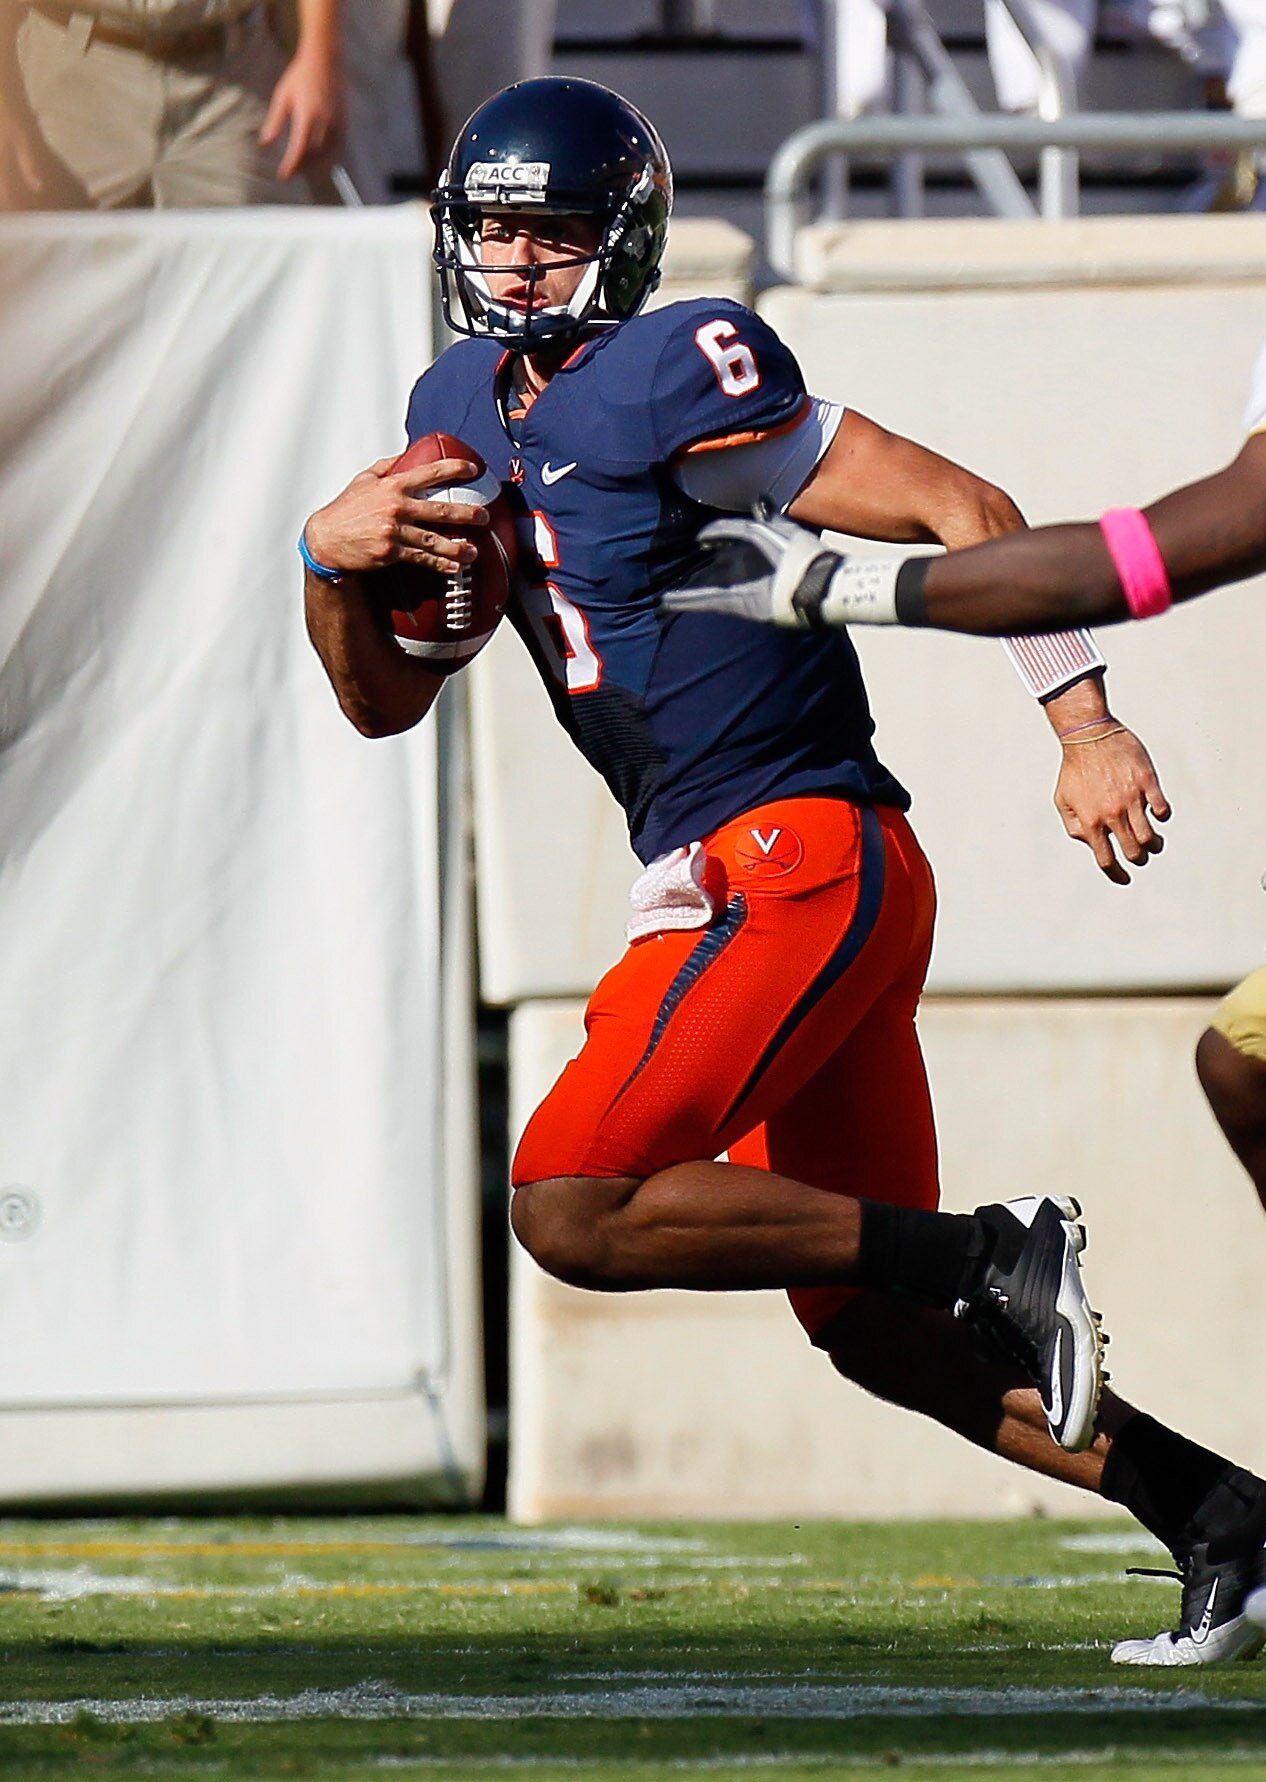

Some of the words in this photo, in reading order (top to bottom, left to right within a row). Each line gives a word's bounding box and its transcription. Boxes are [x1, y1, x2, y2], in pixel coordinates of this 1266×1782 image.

[488, 166, 524, 181] ACC
[692, 317, 763, 398] 6
[515, 510, 605, 695] 6
[750, 828, 782, 855] V
